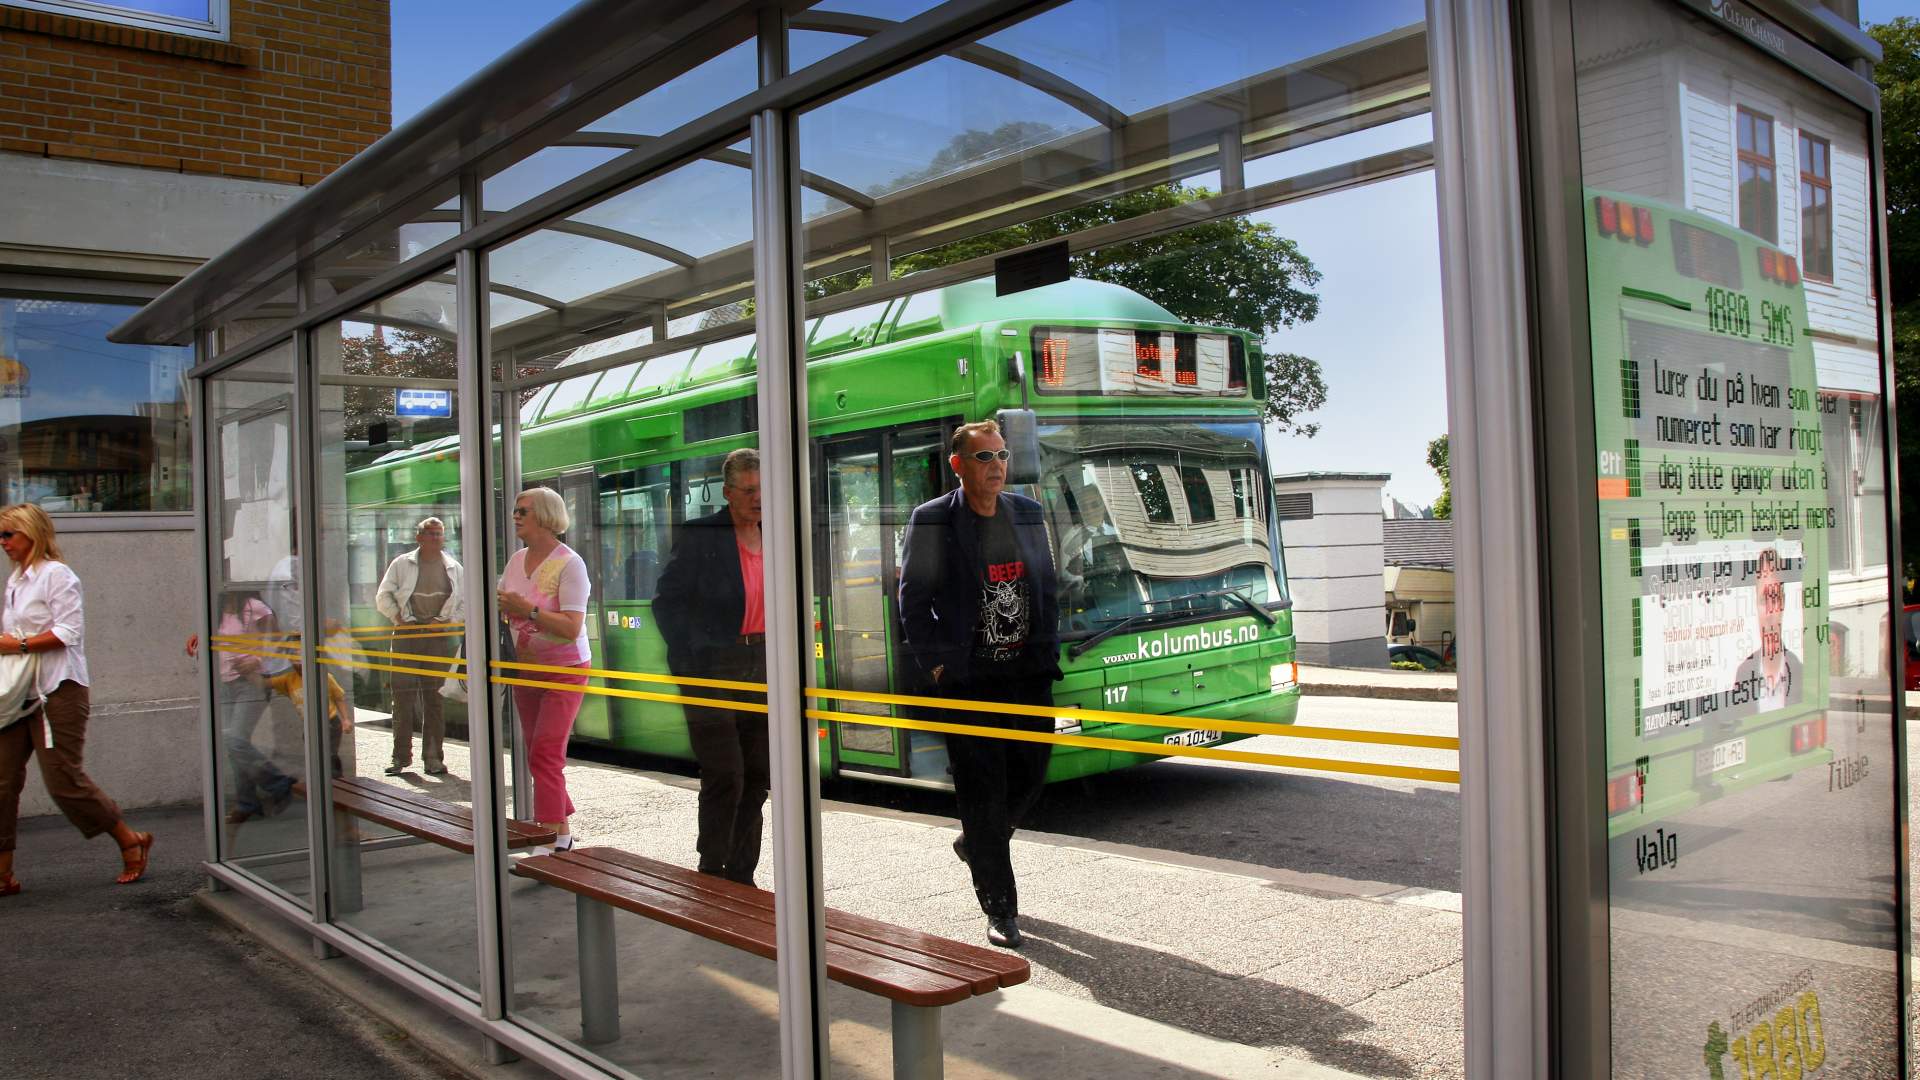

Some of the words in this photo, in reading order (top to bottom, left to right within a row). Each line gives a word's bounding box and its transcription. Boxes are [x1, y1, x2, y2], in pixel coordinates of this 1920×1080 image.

[1761, 300, 1794, 346] SMS
[1654, 359, 1688, 397] Lurer
[1697, 368, 1717, 401] du
[1727, 372, 1744, 408] på
[1751, 374, 1780, 408] hvem
[1788, 387, 1809, 412] som
[1657, 413, 1721, 445] nummeret
[1730, 422, 1754, 446] som
[1760, 418, 1781, 449] har
[1790, 420, 1823, 455] ringt
[1659, 454, 1682, 495] deg
[1689, 456, 1723, 490] åtte
[1732, 465, 1772, 495] ganger
[1782, 460, 1814, 490] uten
[1660, 501, 1696, 541] legge
[1703, 501, 1744, 539] igjen
[1752, 500, 1800, 535] beskjed
[1806, 506, 1836, 529] mens
[1138, 624, 1259, 659] kolumbus.no
[1816, 617, 1830, 645] vi
[1102, 652, 1137, 664] VOLVO
[1105, 685, 1128, 705] 117
[1636, 828, 1677, 875] Valg
